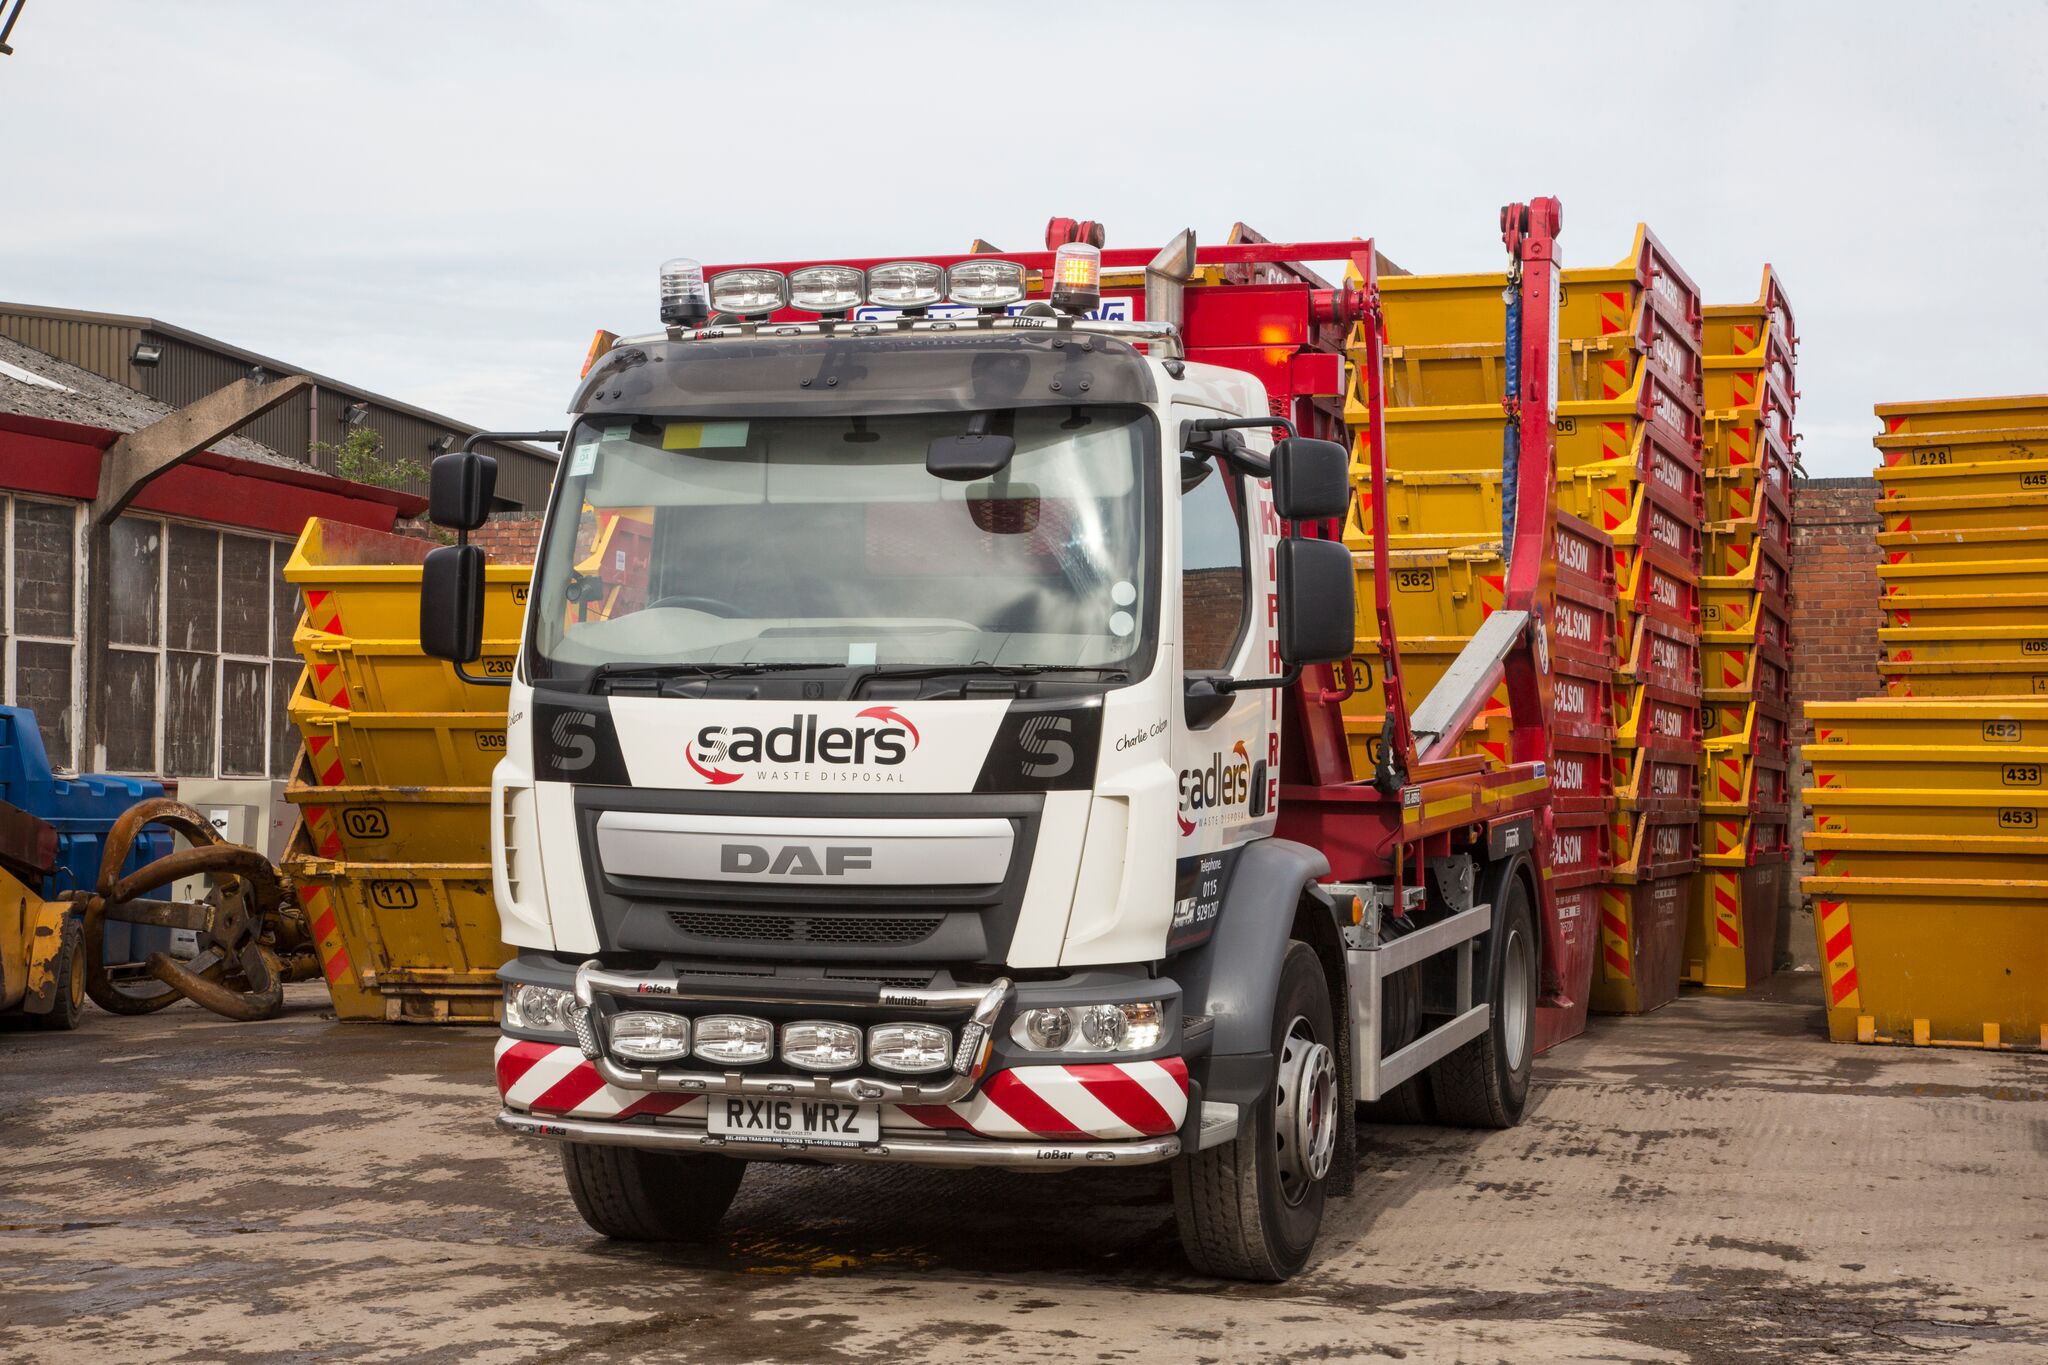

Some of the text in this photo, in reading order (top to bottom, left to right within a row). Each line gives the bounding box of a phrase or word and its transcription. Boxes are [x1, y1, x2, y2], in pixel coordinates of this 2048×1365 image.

[1012, 316, 1047, 329] HiBar
[2024, 475, 2048, 485] 445
[1556, 533, 1589, 574] OLSON
[1401, 573, 1430, 587] 362
[486, 660, 513, 673] 230
[1985, 724, 2017, 737] 452
[479, 735, 506, 748] 309
[697, 713, 907, 766] sadlers
[1115, 728, 1149, 752] Charlie
[757, 770, 905, 783] WASTE DISPOSAL
[1178, 751, 1248, 812] sadlers
[2006, 768, 2038, 781] 433
[352, 814, 382, 834] 02
[2001, 810, 2033, 824] 453
[720, 843, 873, 876] DAF
[381, 886, 407, 904] 11
[1202, 879, 1218, 898] 0115
[885, 994, 928, 1008] MultiBar
[727, 1099, 860, 1134] RX16 WRZ
[1036, 1149, 1074, 1160] LoBar
